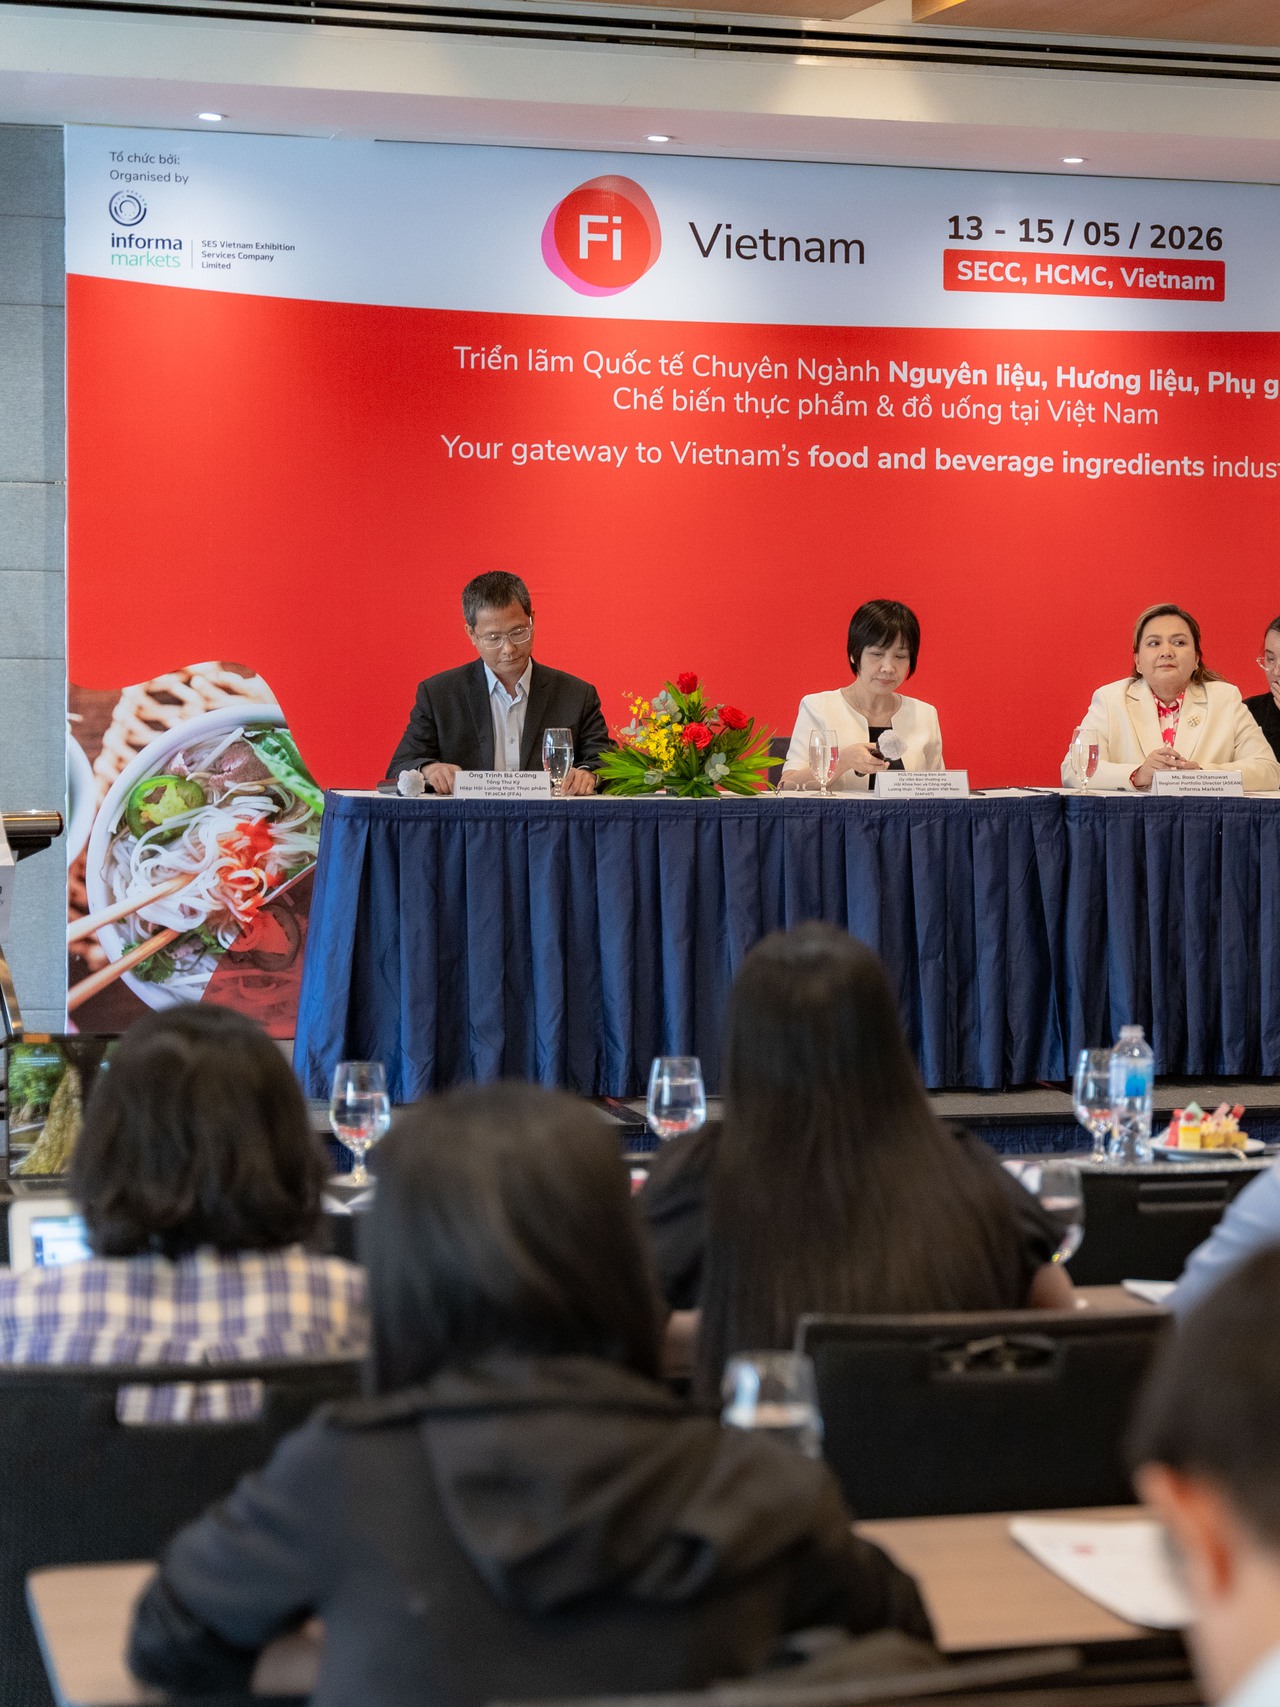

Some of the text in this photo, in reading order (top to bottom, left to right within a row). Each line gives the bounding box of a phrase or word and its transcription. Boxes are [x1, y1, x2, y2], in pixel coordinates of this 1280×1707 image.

[110, 151, 180, 166] Tổ chức bởi:
[110, 170, 189, 185] Organised by
[111, 233, 182, 250] informa
[579, 214, 622, 260] Fi
[688, 222, 865, 264] Vietnam
[948, 215, 983, 240] 13
[1018, 218, 1054, 243] 15
[1063, 219, 1074, 246] /
[1083, 221, 1120, 246] 05
[1128, 222, 1141, 249] /
[1150, 224, 1223, 251] 2026
[201, 240, 295, 251] SES Vietnam Exhibition
[201, 251, 274, 262] Services Company
[111, 251, 180, 268] markets
[201, 262, 231, 270] Limited
[957, 260, 1215, 291] SECC, HCMC, Vietnam
[454, 344, 518, 371] Triển
[528, 348, 574, 373] lãm
[583, 349, 651, 378] Quốc
[658, 351, 684, 376] tế
[692, 354, 788, 383] Chuyên
[797, 355, 879, 386] Ngành
[889, 361, 988, 390] Nguyên
[996, 363, 1047, 390] liệu,
[1056, 365, 1141, 395] Hương
[1149, 368, 1200, 395] liệu,
[1208, 371, 1256, 399] Phụ
[613, 385, 1158, 427] Chế biến thực phẩm & đồ uống tại Việt Nam
[441, 434, 503, 459] Your
[511, 438, 628, 468] gateway
[635, 442, 662, 463] to
[808, 445, 868, 468] food
[877, 448, 927, 469] and
[935, 448, 1054, 477] beverage
[1062, 450, 1205, 480] ingredients
